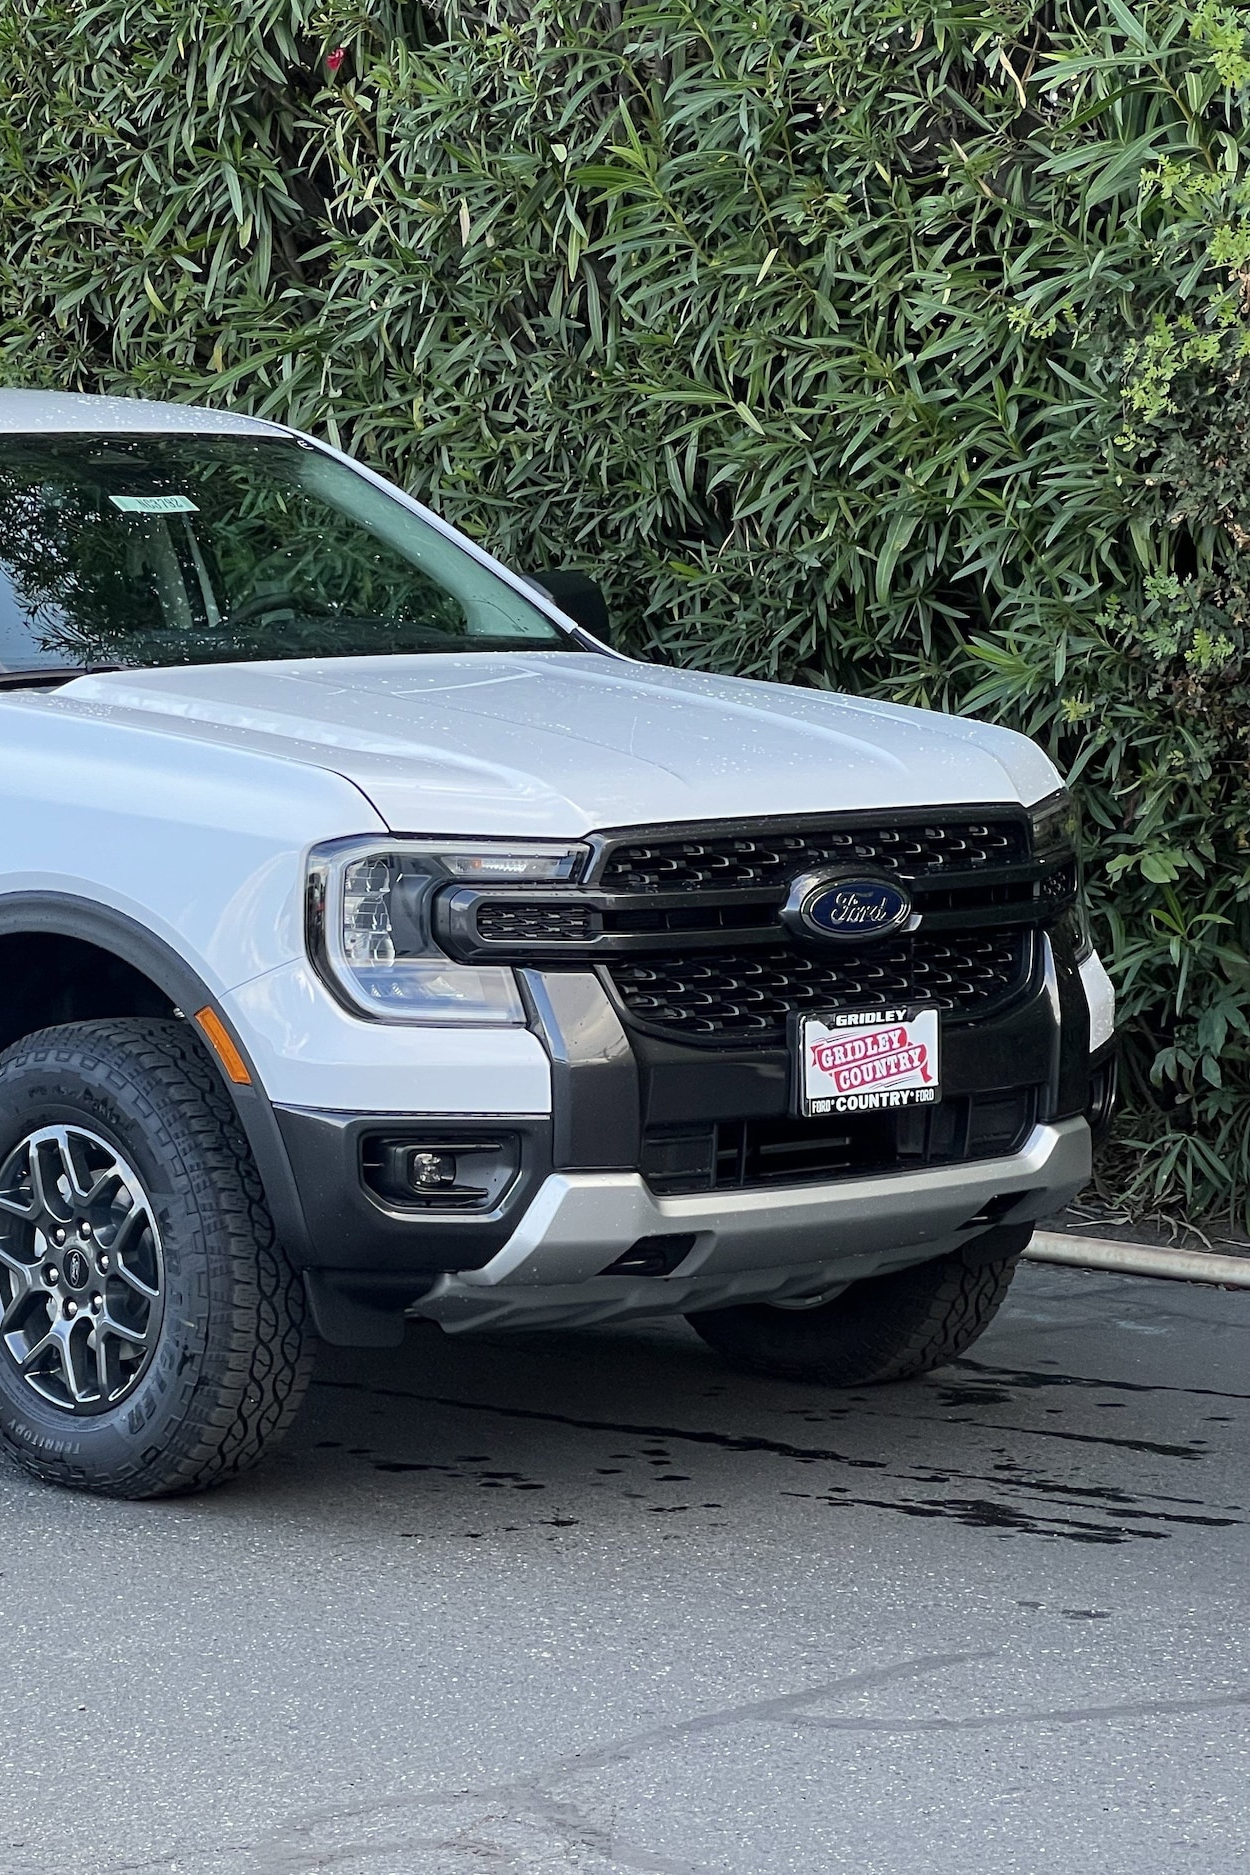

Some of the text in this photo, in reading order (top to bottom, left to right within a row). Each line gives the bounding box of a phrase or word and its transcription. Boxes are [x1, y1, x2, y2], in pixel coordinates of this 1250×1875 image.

[830, 890, 887, 924] Ford
[835, 1009, 907, 1027] GRIDLEY
[821, 1029, 903, 1068] GRIDLEY
[839, 1046, 922, 1090] COUNTRY
[812, 1088, 935, 1114] FORD COUNTRY FORD
[6, 1418, 82, 1455] TERRITORY
